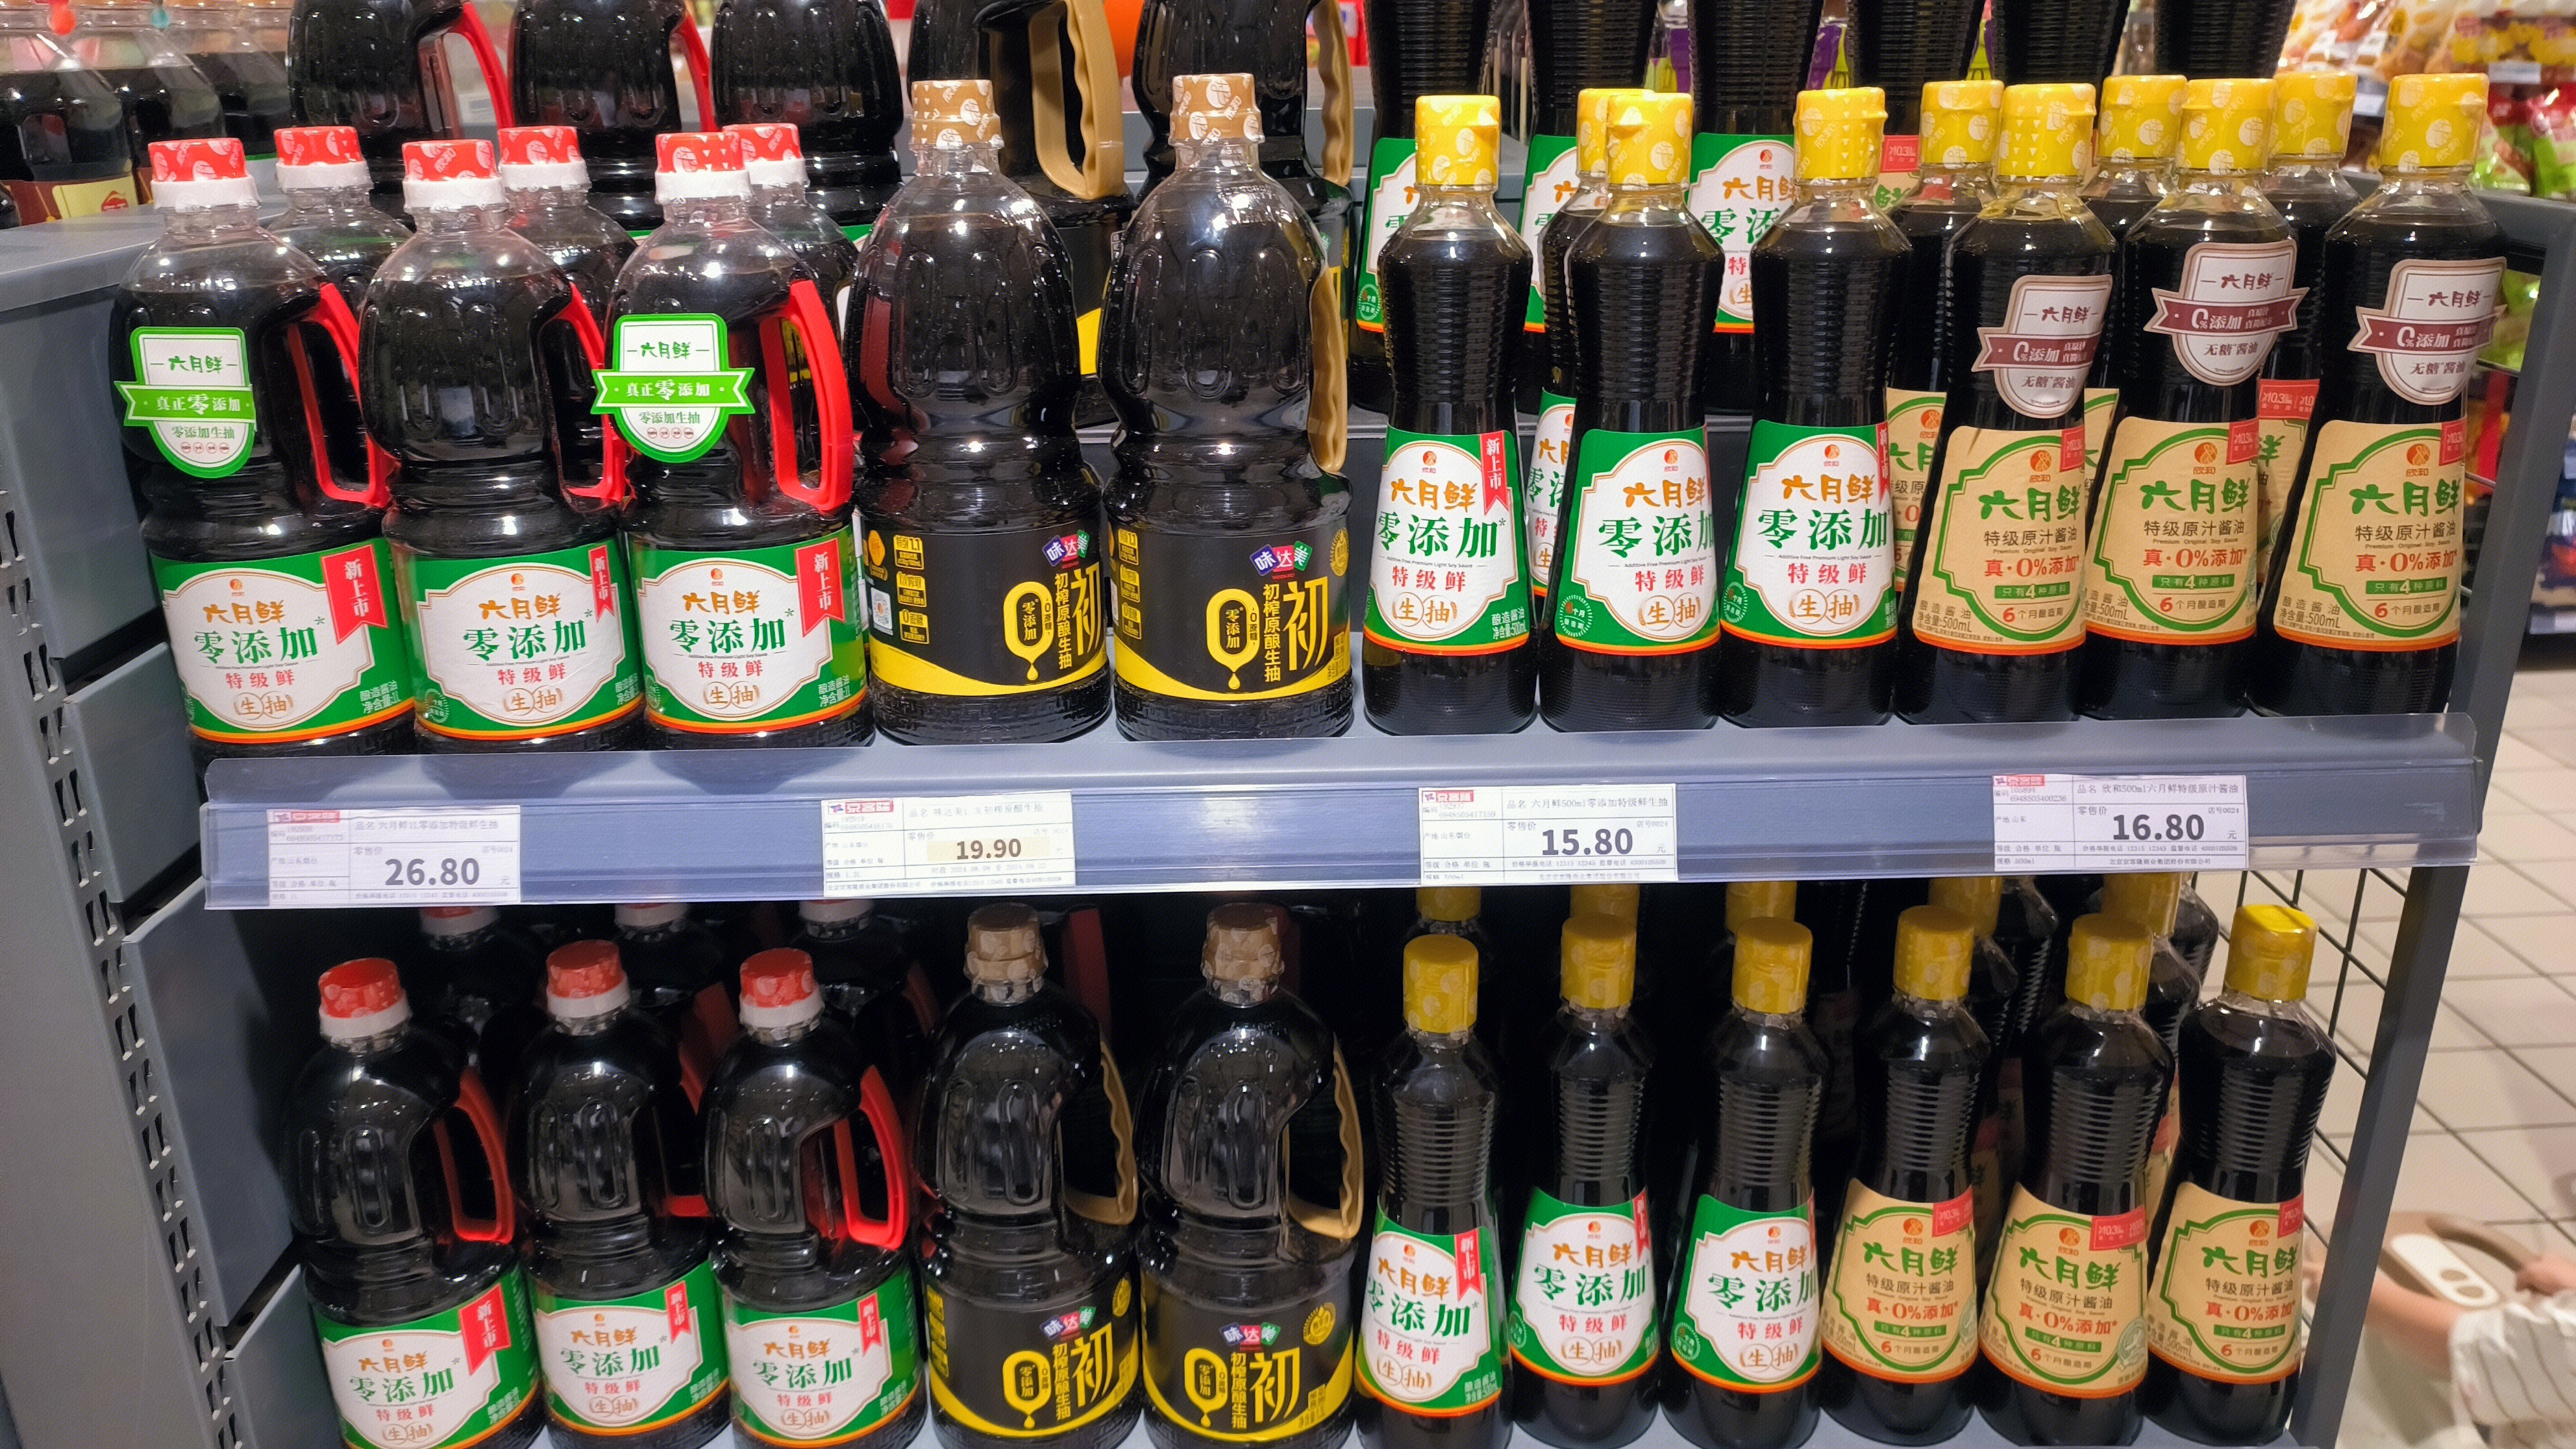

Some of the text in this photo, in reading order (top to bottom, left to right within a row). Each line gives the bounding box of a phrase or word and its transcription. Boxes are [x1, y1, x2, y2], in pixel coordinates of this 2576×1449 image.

[2221, 273, 2272, 290] 六月鲜
[2429, 290, 2481, 308] 六月鲜
[2042, 306, 2090, 323] 六月鲜
[640, 341, 691, 359] 六月鲜
[168, 355, 223, 373] 六月鲜
[627, 379, 710, 401] 真正零添加
[156, 393, 241, 415] 真正零添加
[1486, 438, 1502, 489] 新上市
[2193, 467, 2216, 475] 欣和
[1391, 479, 1478, 512] 六月鲜
[1623, 477, 1705, 508] 六月鲜
[1781, 474, 1876, 504] 六月鲜
[2140, 478, 2251, 514] 六月鲜
[2349, 478, 2461, 517] 六月鲜
[1979, 484, 2080, 522] 六月鲜
[1378, 511, 1498, 558] 零添加
[1598, 511, 1713, 558] 零添加
[1757, 508, 1887, 551] 零添加
[1984, 526, 2077, 547] 特级原汁酱油
[2144, 519, 2245, 536] 特级原汁酱油
[2355, 521, 2456, 542] 特级原汁酱油
[1046, 534, 1088, 561] 味达美
[1254, 546, 1309, 571] 味达美
[814, 552, 832, 611] 新上市
[1393, 566, 1466, 591] 特级鲜
[1635, 565, 1704, 592] 特级鲜
[1788, 563, 1866, 584] 特级鲜
[343, 558, 369, 617] 新上市
[203, 600, 285, 625] 六月鲜
[478, 593, 562, 619] 六月鲜
[682, 590, 760, 615] 六月鲜
[1071, 562, 1100, 656] 初
[1055, 573, 1072, 670] 初榨原酿生抽
[1263, 584, 1281, 682] 初榨原酿生抽
[1283, 576, 1328, 671] 初
[194, 627, 318, 663] 零添加
[463, 619, 586, 662] 零添加
[670, 618, 786, 654] 零添加
[226, 670, 295, 689] 特级鲜
[498, 663, 565, 686] 特级鲜
[699, 660, 763, 678] 特级鲜
[2077, 783, 2239, 794] 品名 欣和500ml六月鲜特级原汁酱油
[1507, 799, 1526, 809] 品名
[2077, 806, 2107, 815] 零售价
[1507, 821, 1536, 831] 零售价
[2113, 814, 2237, 840] 16.80 元
[956, 838, 1022, 860] 19.90
[1542, 828, 1666, 856] 15.80 元
[385, 858, 480, 886] 26.80
[1553, 1241, 1633, 1268] 六月鲜
[1731, 1242, 1808, 1273] 六月鲜
[1863, 1242, 1959, 1276] 六月鲜
[2201, 1244, 2299, 1278] 六月鲜
[1378, 1257, 1452, 1300] 六月鲜
[2020, 1246, 2122, 1292] 六月鲜
[1534, 1263, 1646, 1306] 零添加
[1708, 1269, 1816, 1312] 零添加
[1866, 1273, 1954, 1294] 特级原汁酱油
[2021, 1278, 2113, 1309] 特级原汁酱油
[2206, 1276, 2294, 1297] 特级原汁酱油
[1368, 1276, 1470, 1337] 零添加
[571, 1326, 637, 1346] 六月鲜
[1559, 1314, 1628, 1333] 特级鲜
[1738, 1317, 1803, 1339] 特级鲜
[561, 1345, 660, 1377] 零添加
[764, 1338, 830, 1358] 六月鲜
[1378, 1330, 1440, 1365] 特级鲜
[358, 1350, 428, 1373] 六月鲜
[753, 1357, 852, 1389] 零添加
[1071, 1322, 1113, 1407] 初
[349, 1368, 454, 1402] 零添加
[777, 1391, 832, 1406] 特级鲜
[1250, 1347, 1300, 1423] 初
[377, 1404, 434, 1421] 特级鲜
